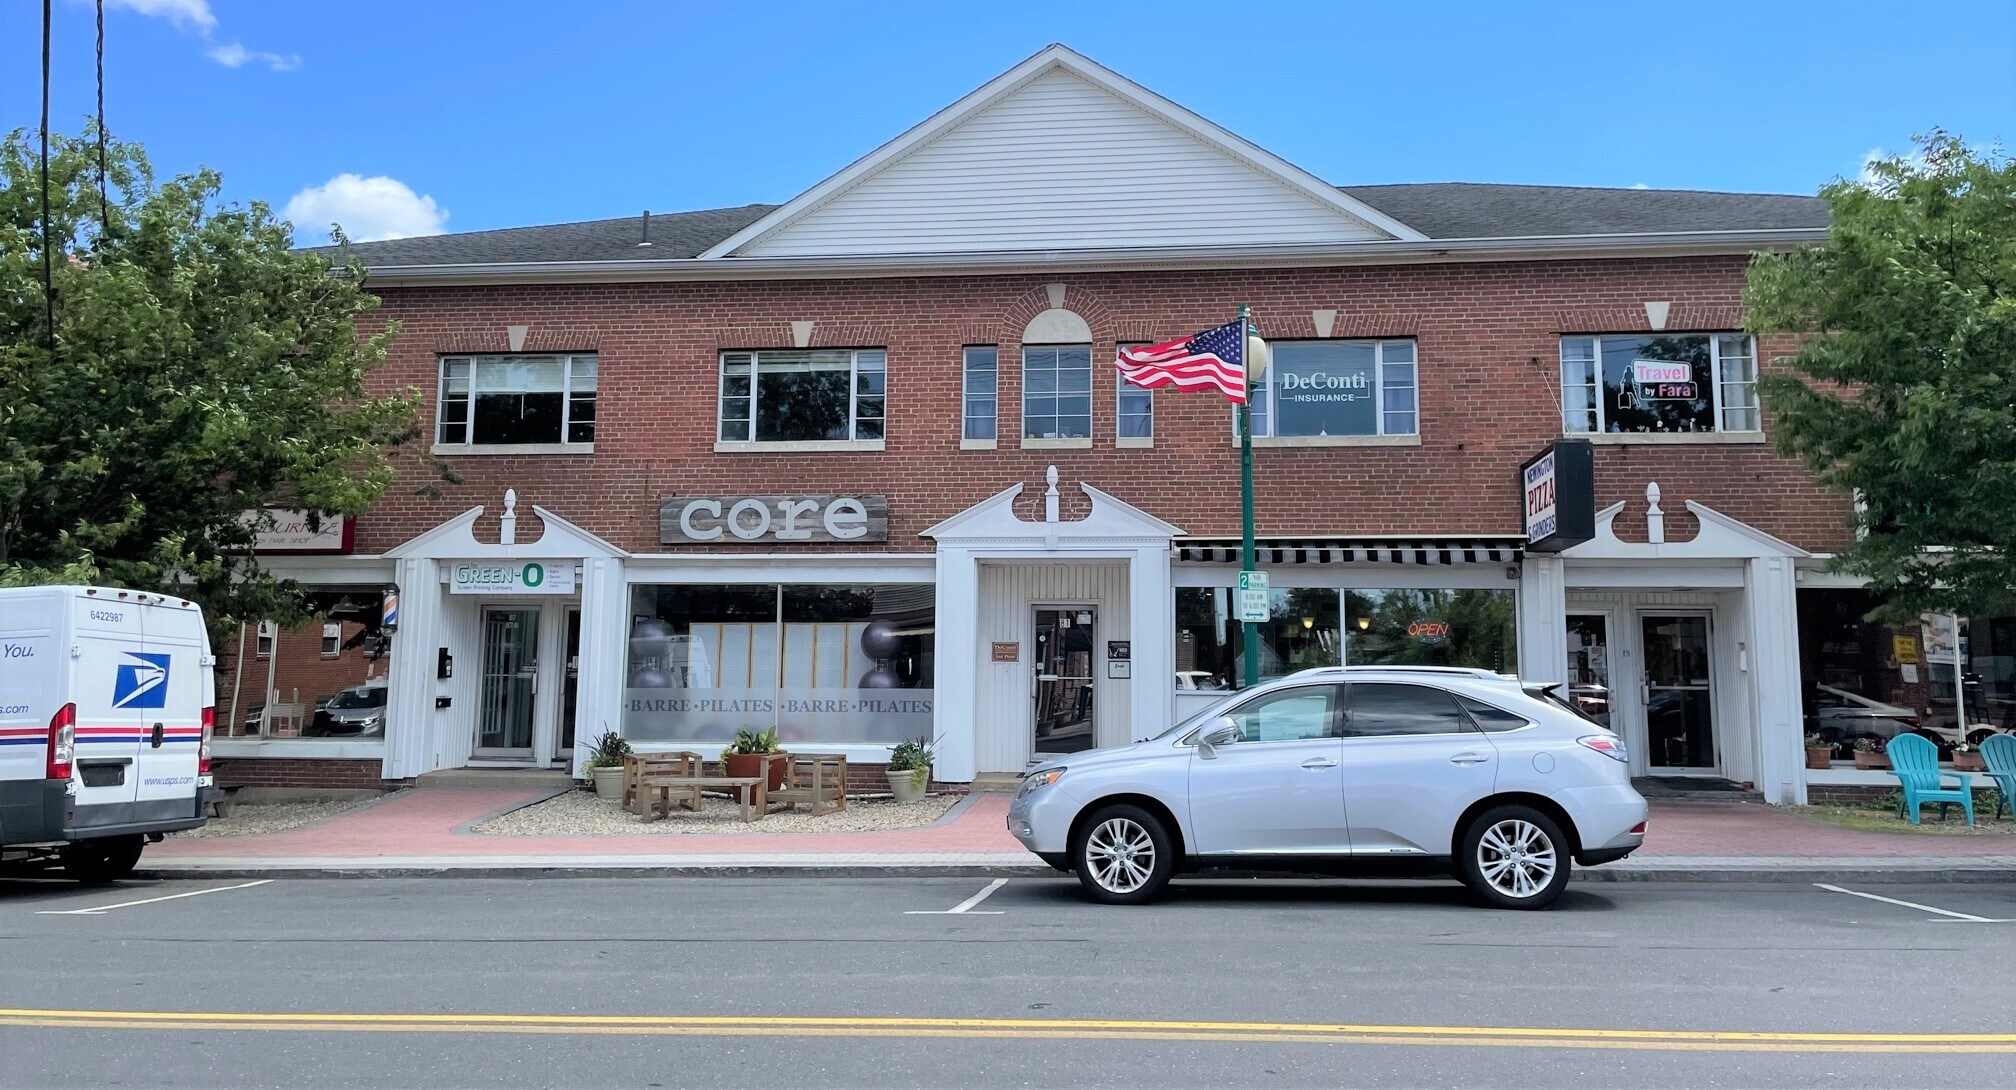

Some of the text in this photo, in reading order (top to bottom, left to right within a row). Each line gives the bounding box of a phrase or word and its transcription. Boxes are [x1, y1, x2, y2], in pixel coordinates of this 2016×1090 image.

[1636, 365, 1687, 381] Travel
[1283, 371, 1367, 390] DeConti
[1645, 384, 1692, 397] by Fara
[1294, 394, 1355, 402] INSURANCE
[1527, 454, 1554, 485] NEWINGTON
[1528, 477, 1555, 517] PIZZA
[680, 498, 868, 540] core
[1240, 575, 1248, 588] 2
[90, 610, 123, 623] 6422987
[1060, 618, 1069, 628] 81
[1408, 623, 1449, 636] OPEN
[4, 643, 34, 658] You.
[630, 699, 932, 713] BARRE PILATES BARRE PILATES
[144, 776, 194, 787] www.usps.com
